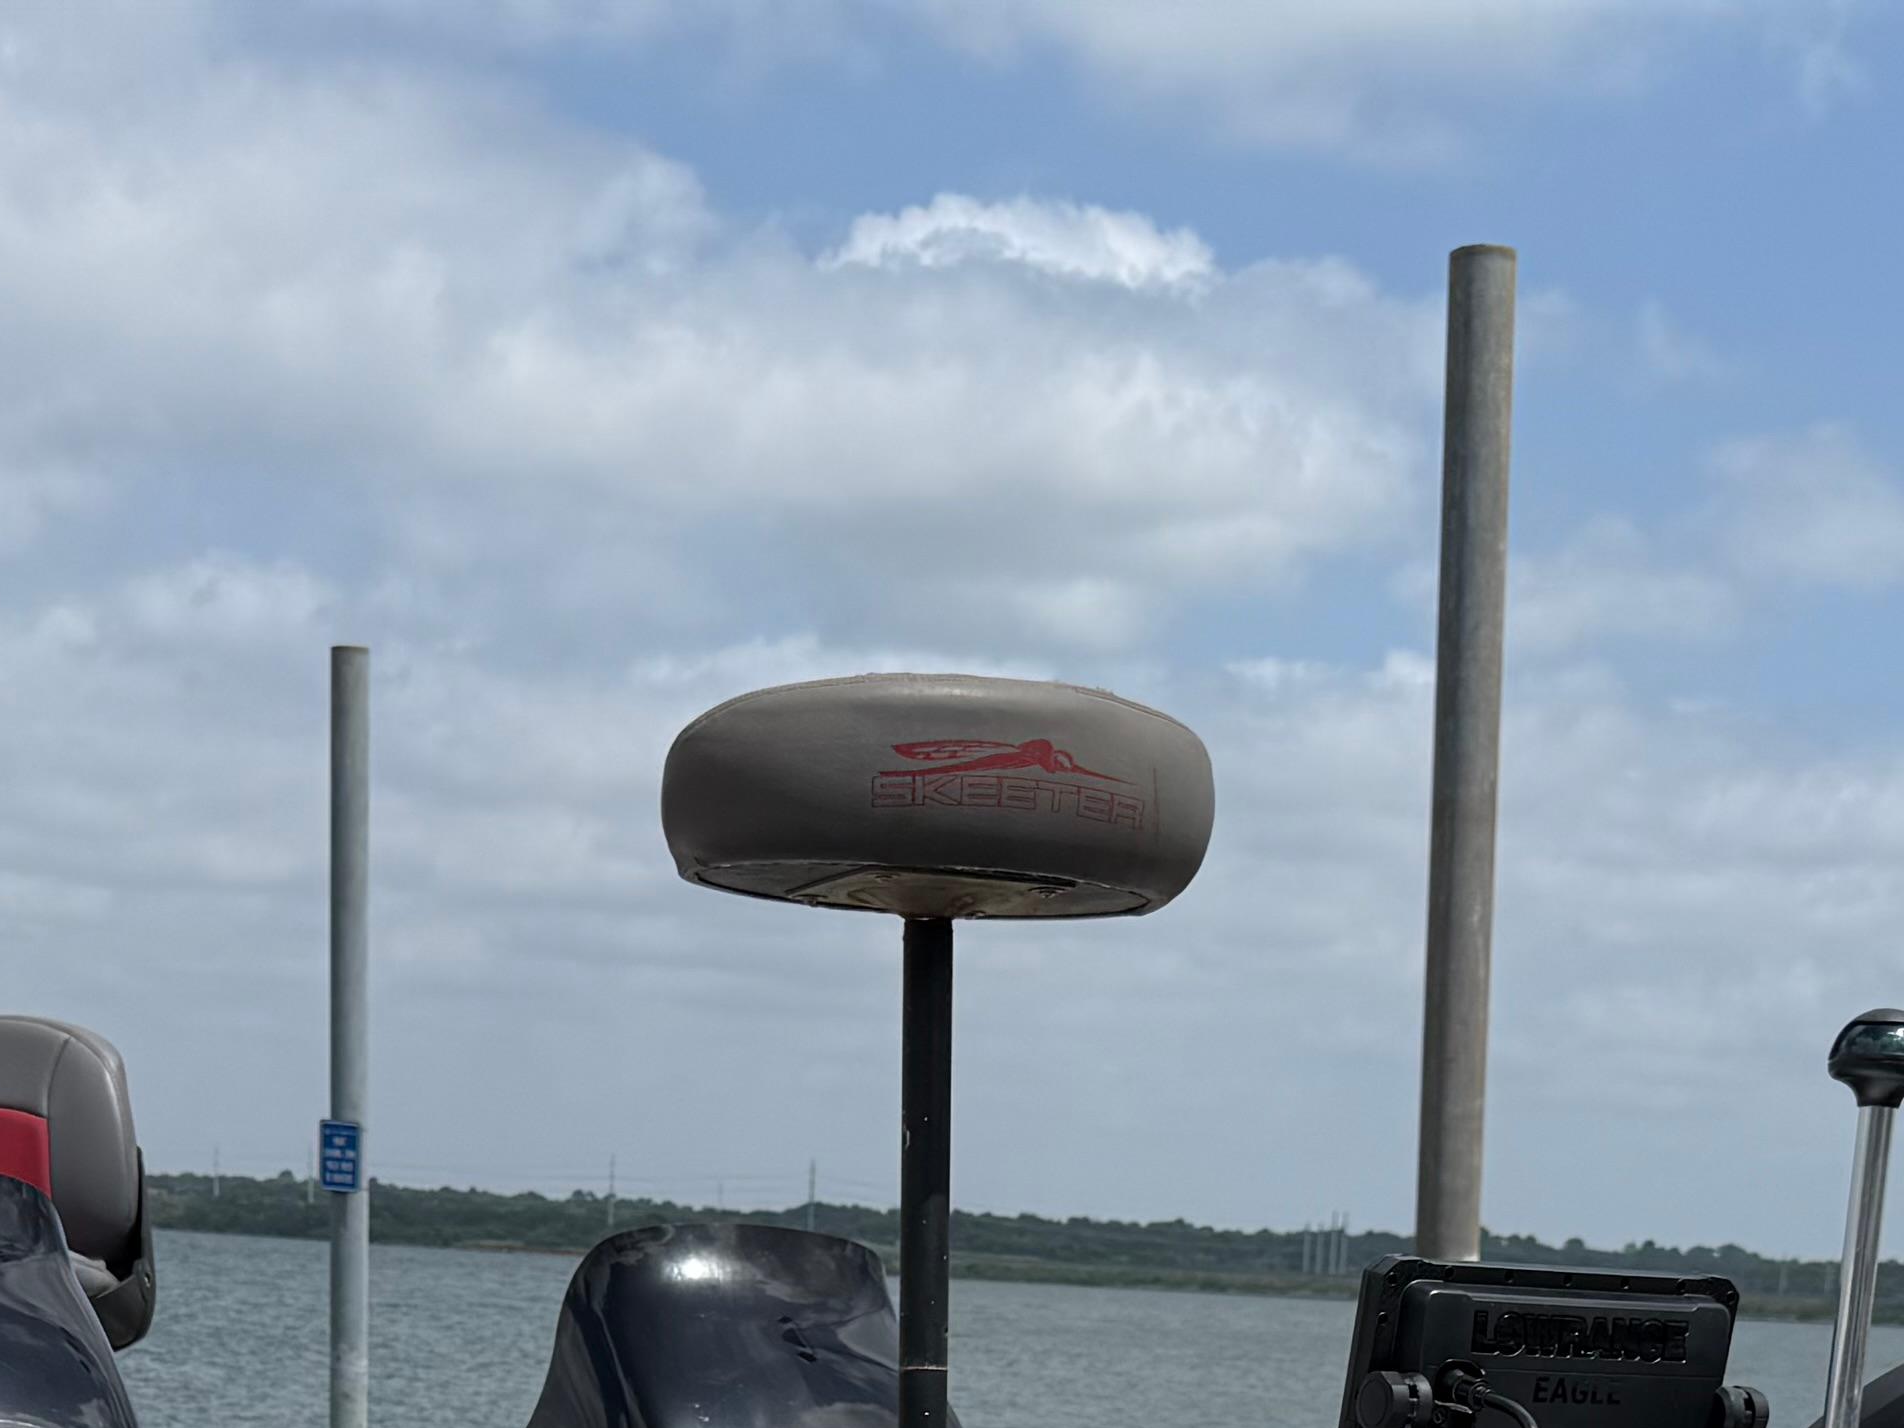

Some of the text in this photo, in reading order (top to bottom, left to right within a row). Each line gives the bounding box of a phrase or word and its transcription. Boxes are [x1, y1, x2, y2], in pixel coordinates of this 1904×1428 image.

[872, 774, 1145, 829] SKEETER
[1471, 1310, 1690, 1365] LOWRANCE
[1533, 1376, 1622, 1406] EAGLE
